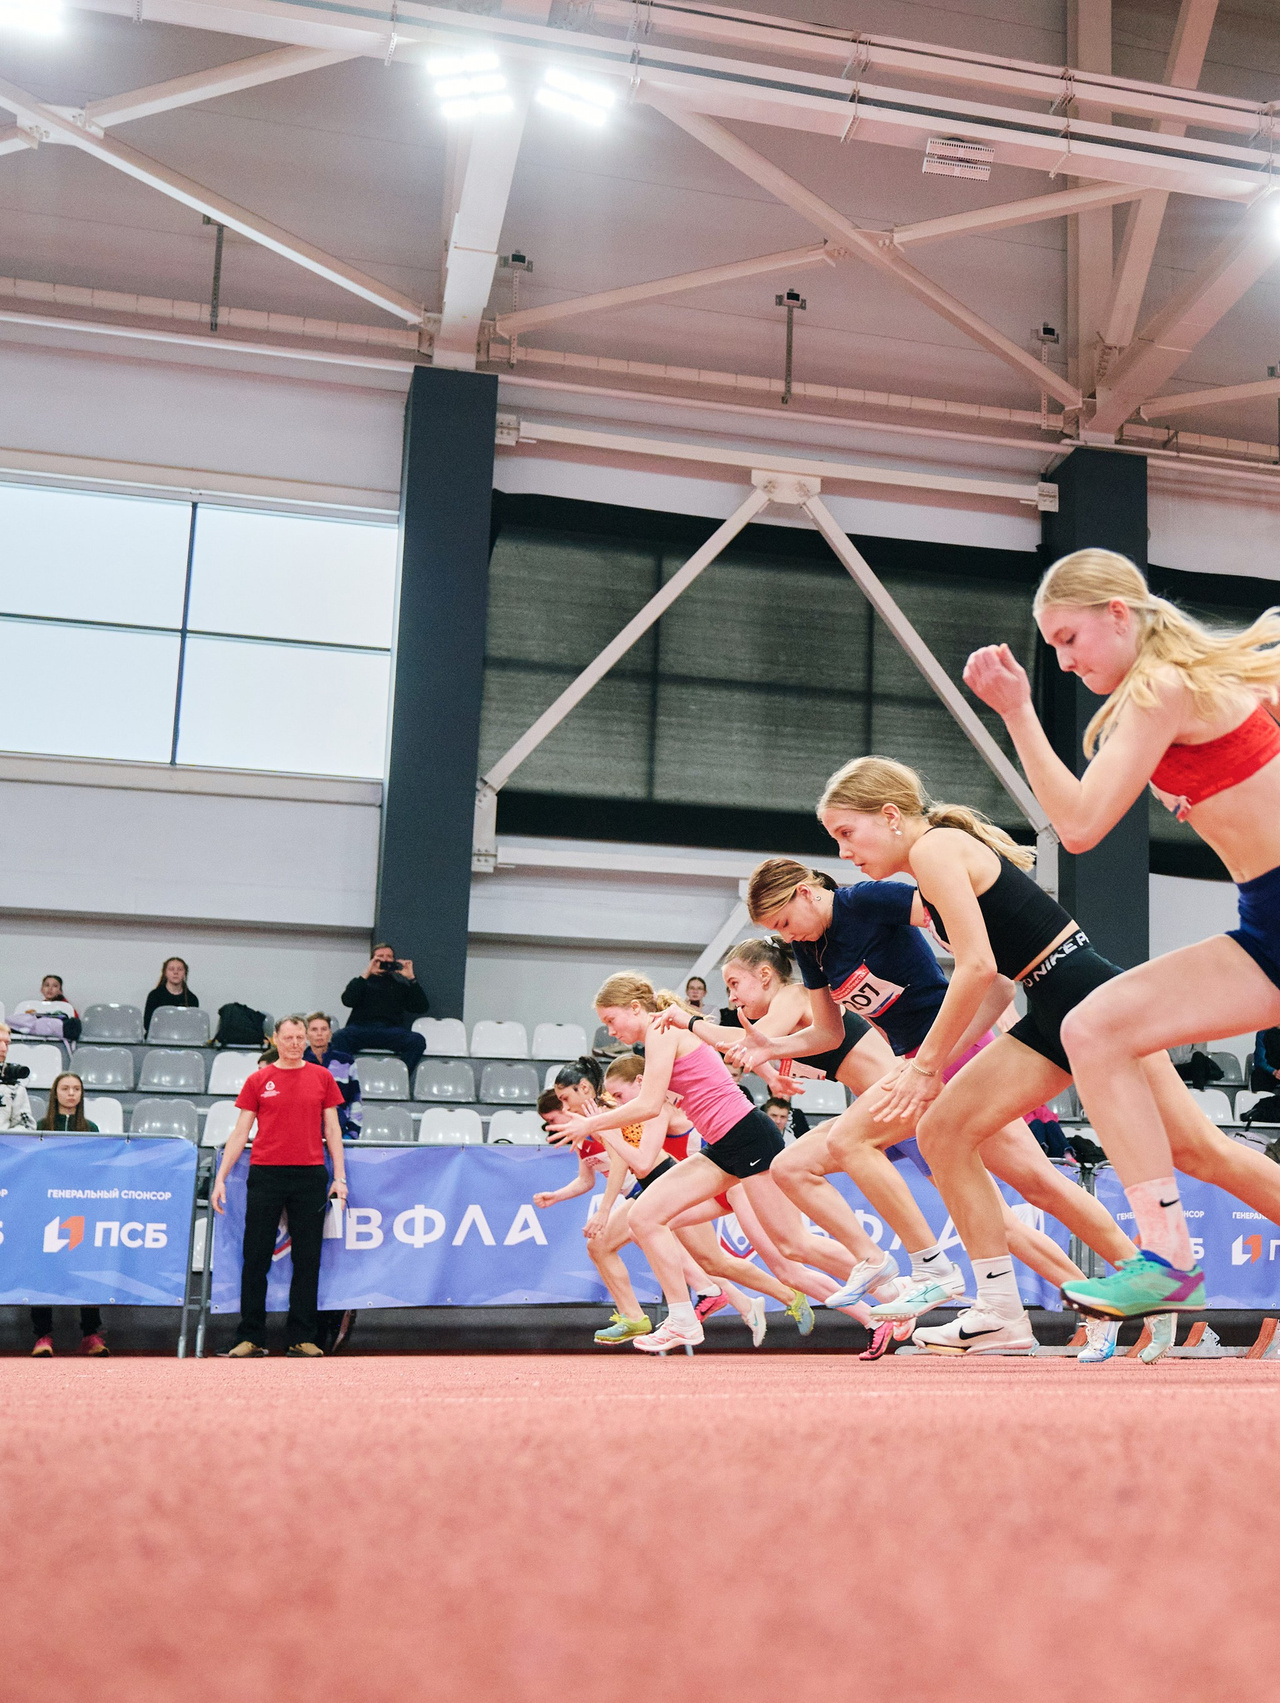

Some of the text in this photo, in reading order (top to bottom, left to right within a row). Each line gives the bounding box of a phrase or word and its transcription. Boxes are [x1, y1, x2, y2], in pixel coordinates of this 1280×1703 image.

[1032, 938, 1078, 982] NIKE
[842, 982, 881, 1012] 207
[47, 1187, 172, 1201] ГЕНЕРАЛЬНЫЙ СПОНСОР
[94, 1221, 169, 1249] ПСБ
[345, 1204, 548, 1250] ВФЛА
